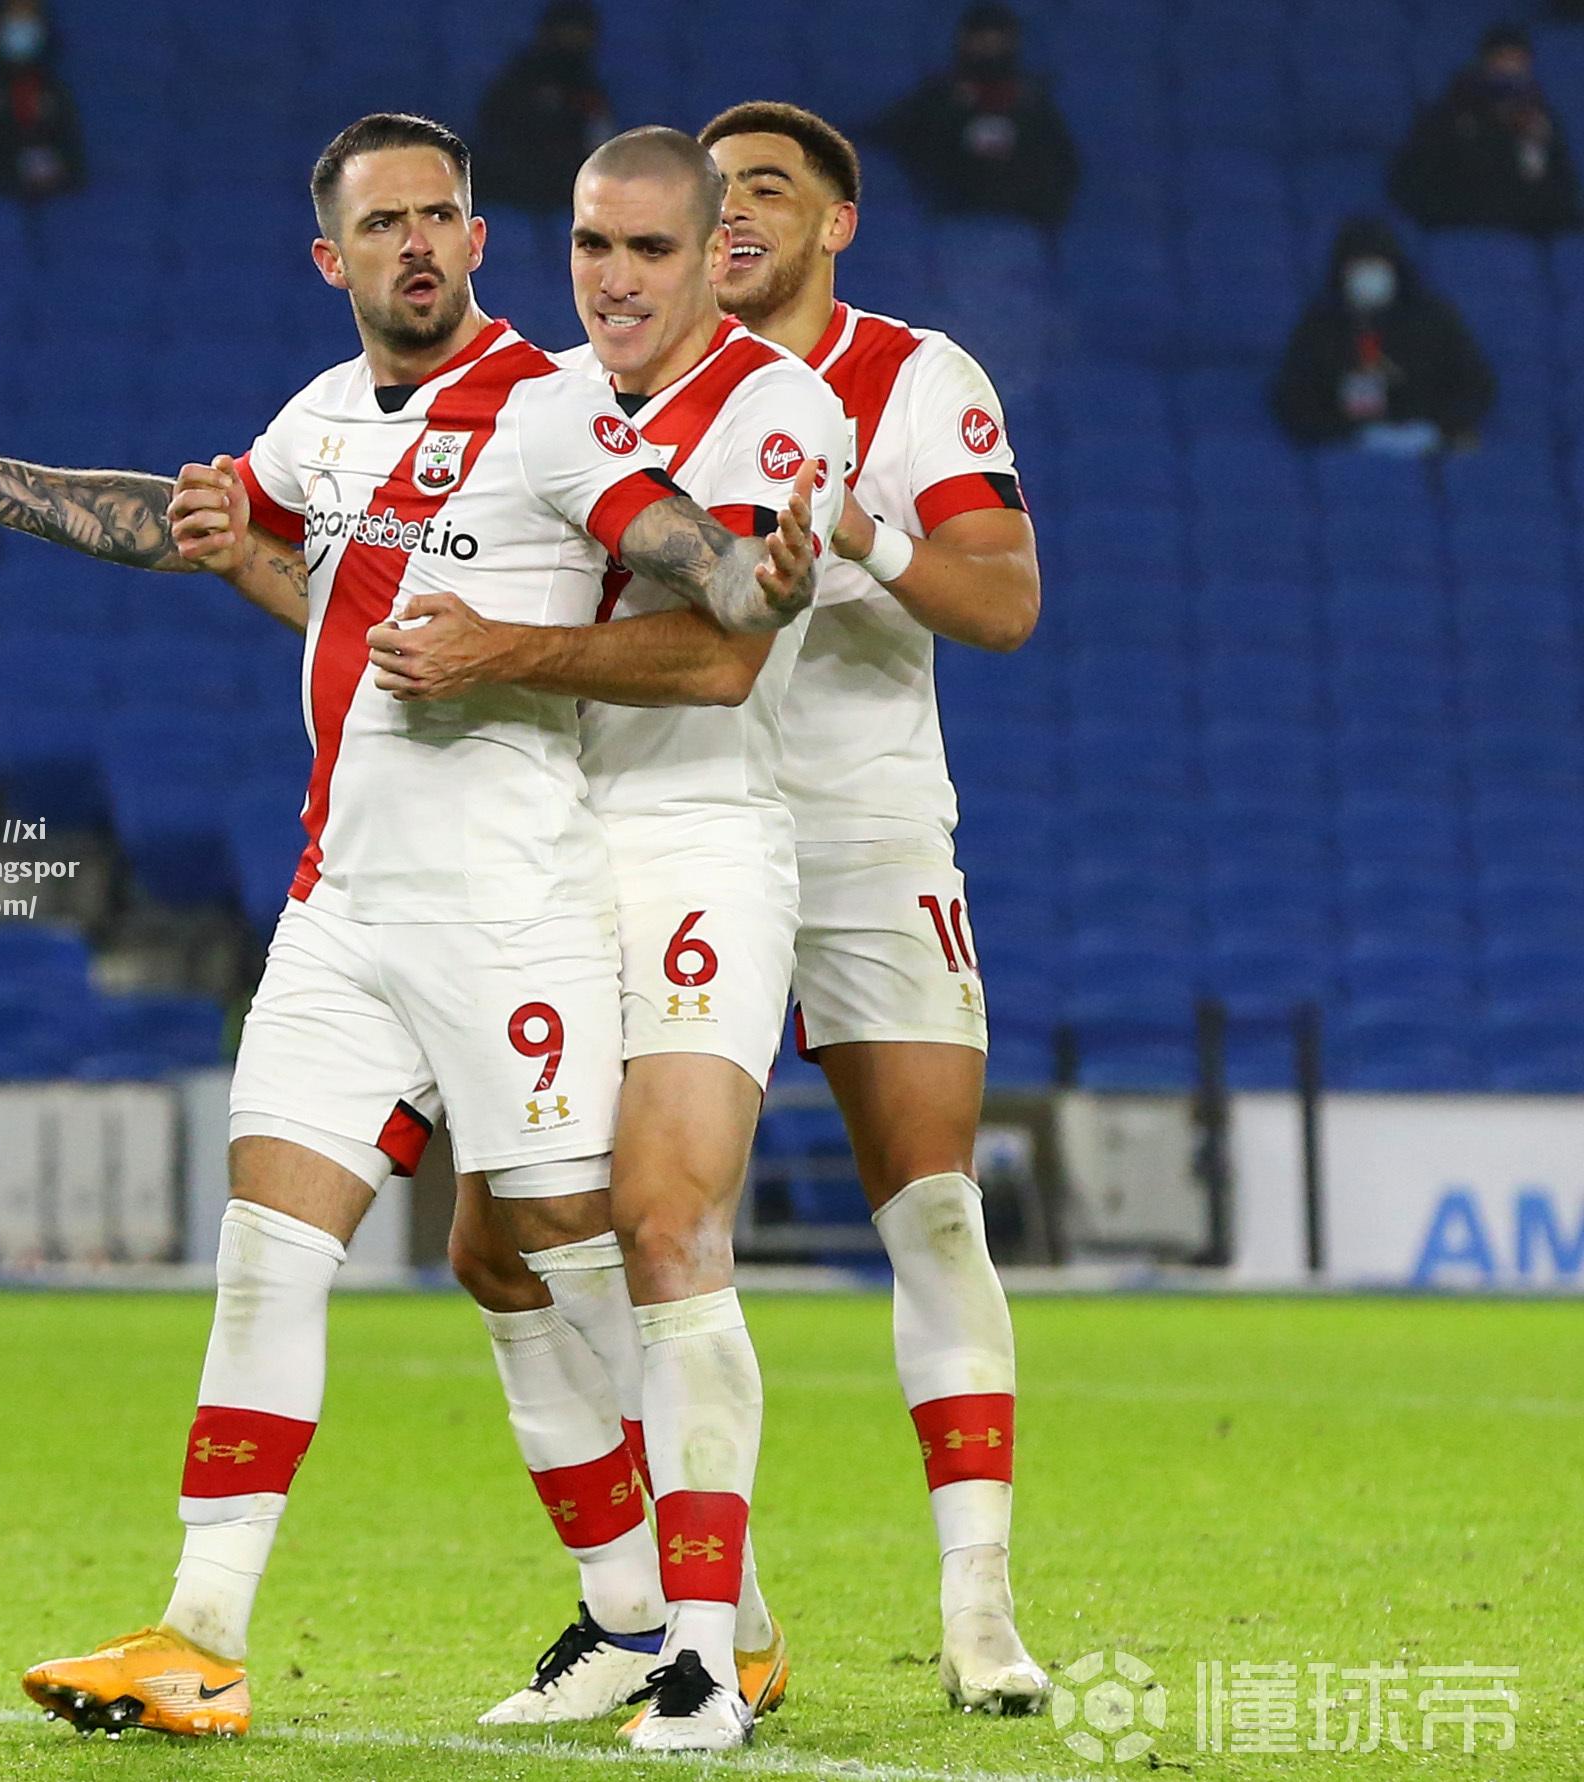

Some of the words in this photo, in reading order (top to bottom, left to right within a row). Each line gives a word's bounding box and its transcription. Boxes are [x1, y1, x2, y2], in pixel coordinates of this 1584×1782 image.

[764, 439, 802, 474] Virgin
[964, 414, 995, 447] Virgin
[304, 503, 479, 561] Sportsbet.io
[663, 910, 718, 987] 6
[507, 1001, 565, 1093] 9
